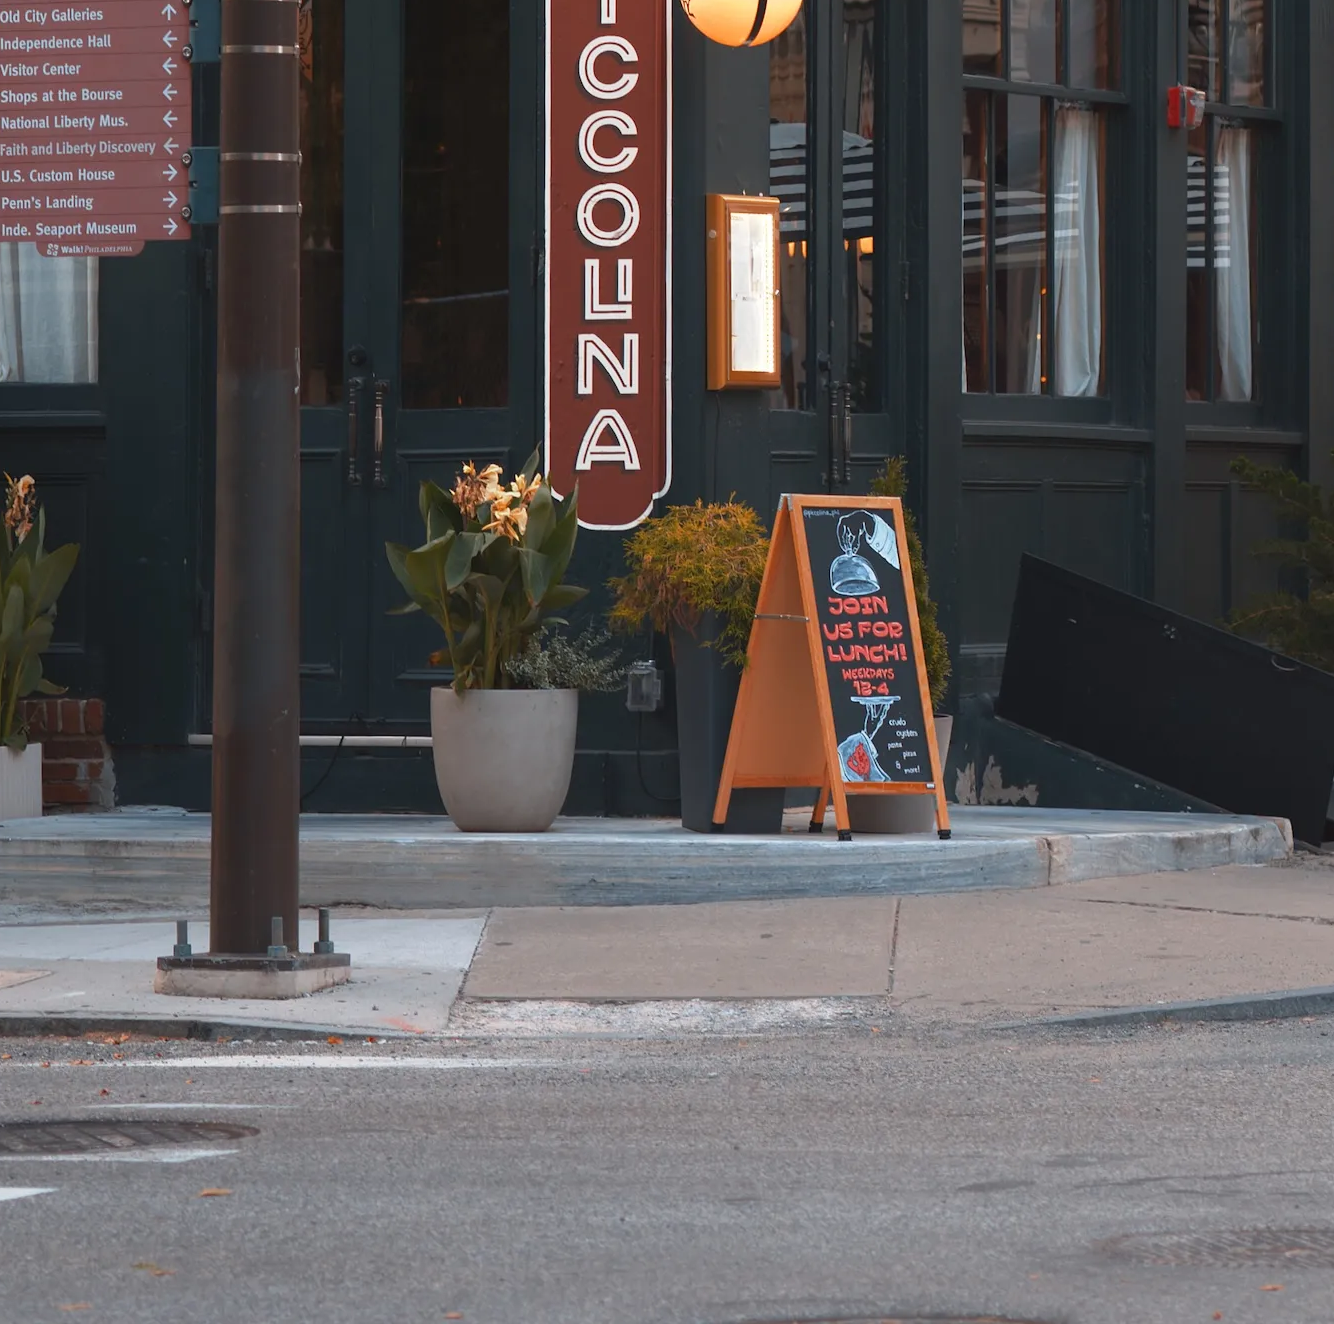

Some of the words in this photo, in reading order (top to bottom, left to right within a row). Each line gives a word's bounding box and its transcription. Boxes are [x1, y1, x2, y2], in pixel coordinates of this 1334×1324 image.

[0, 9, 20, 23] Old
[25, 8, 47, 26] City
[51, 8, 103, 22] Galleries
[0, 35, 83, 51] Independence
[88, 34, 111, 48] Hall
[0, 63, 38, 77] Visitor
[42, 62, 81, 76] Center
[1, 89, 38, 105] Shops
[42, 90, 53, 102] at
[57, 88, 77, 102] the
[82, 87, 122, 101] Bourse
[1, 115, 50, 129] National
[54, 115, 95, 131] Liberty
[100, 114, 129, 127] Mus.
[0, 142, 29, 157] Faith
[32, 142, 53, 156] and
[56, 141, 96, 157] Liberty
[99, 140, 156, 156] Discovery
[1, 168, 25, 183] U.S.
[29, 168, 73, 182] Custom
[78, 167, 115, 181] House
[1, 195, 42, 210] Penn's
[46, 195, 93, 211] Landing
[1, 223, 32, 237] Inde.
[36, 222, 82, 238] Seaport
[86, 221, 137, 235] Museum
[84, 245, 133, 253] PHILADELPHIA
[828, 596, 888, 615] JOIN
[823, 621, 853, 641] US
[857, 621, 903, 640] FOR
[827, 643, 907, 663] LUNCH!
[842, 667, 894, 681] WEEKDAYS
[853, 680, 889, 696] 12-4
